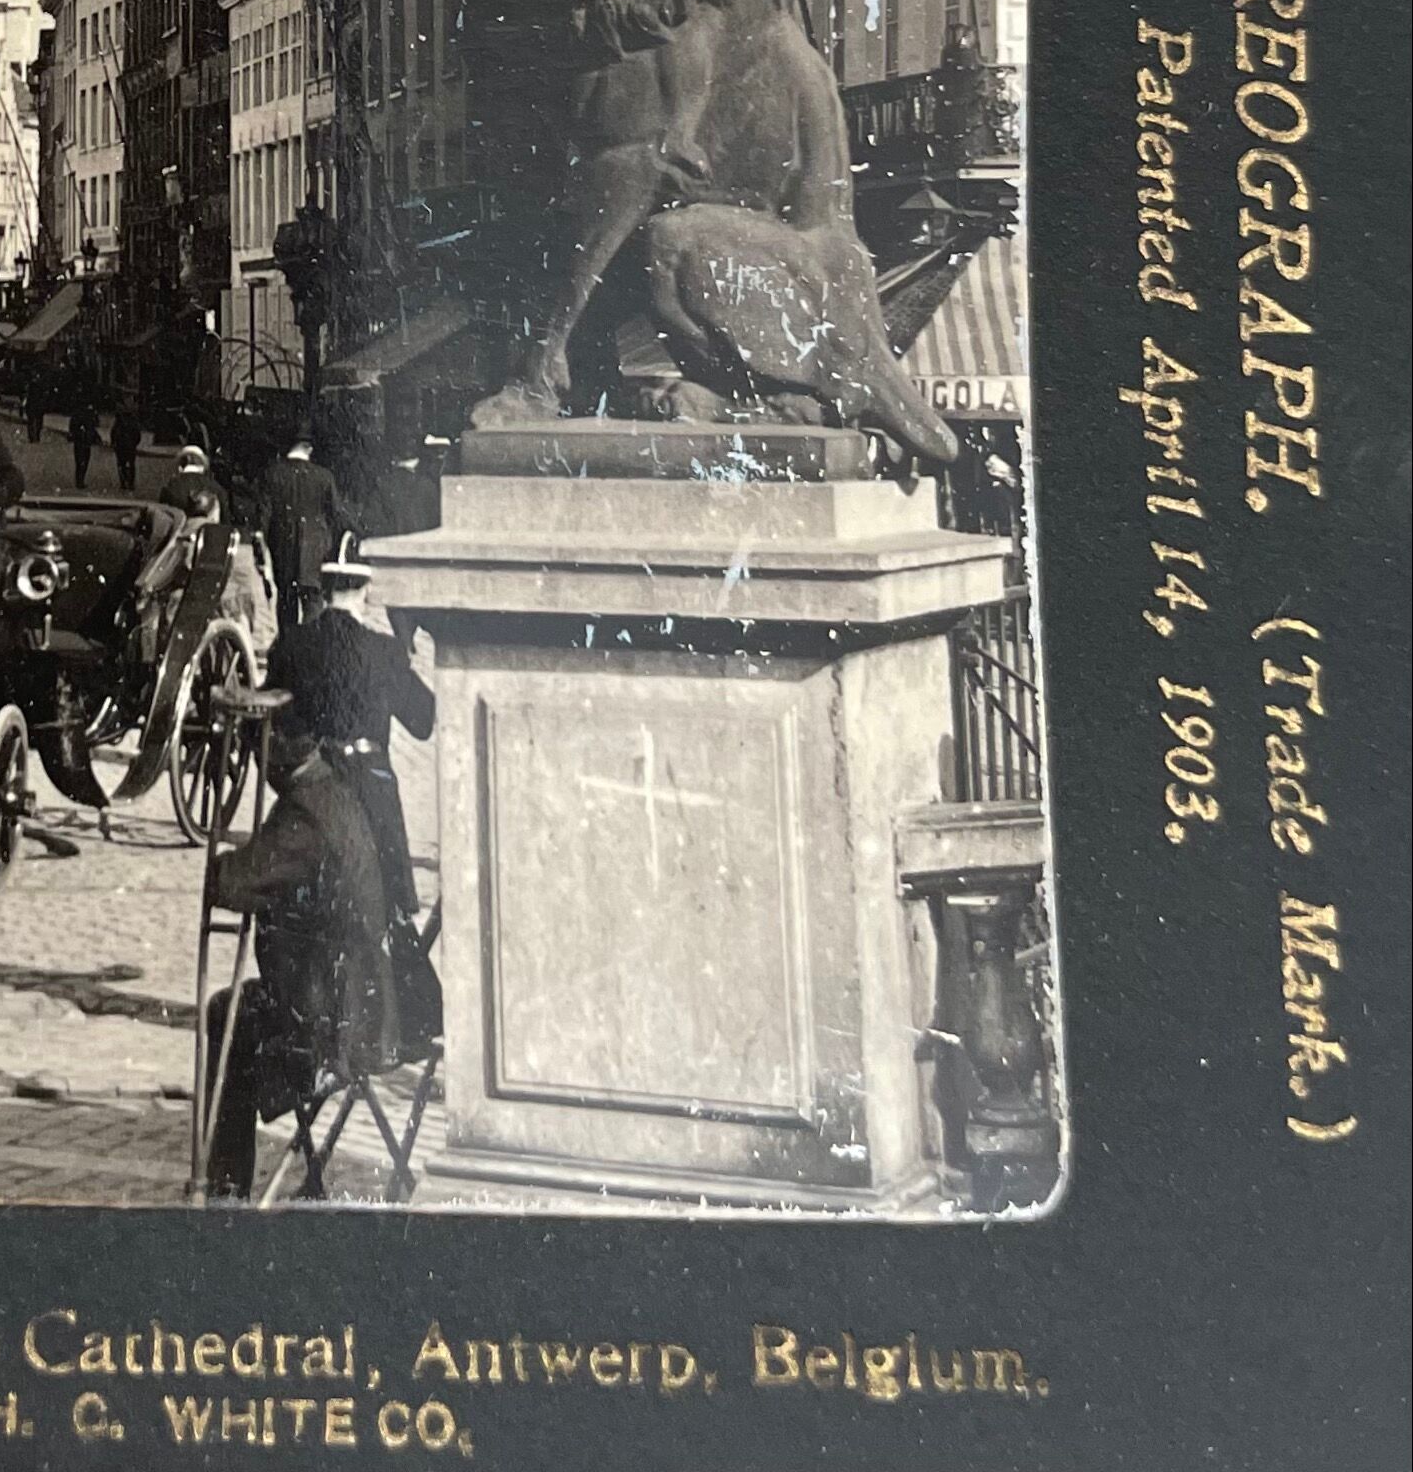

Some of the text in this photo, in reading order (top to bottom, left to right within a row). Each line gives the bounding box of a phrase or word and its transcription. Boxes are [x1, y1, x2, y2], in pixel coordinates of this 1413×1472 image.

[1135, 17, 1199, 311] Patented
[1118, 336, 1204, 519] April
[1142, 541, 1209, 638] 14,
[1157, 676, 1221, 845] 1903.
[1251, 617, 1328, 855] (Trade
[23, 1308, 381, 1390] Cathedral,
[753, 1326, 1049, 1402] Belgium.
[162, 1395, 358, 1447] WHITE
